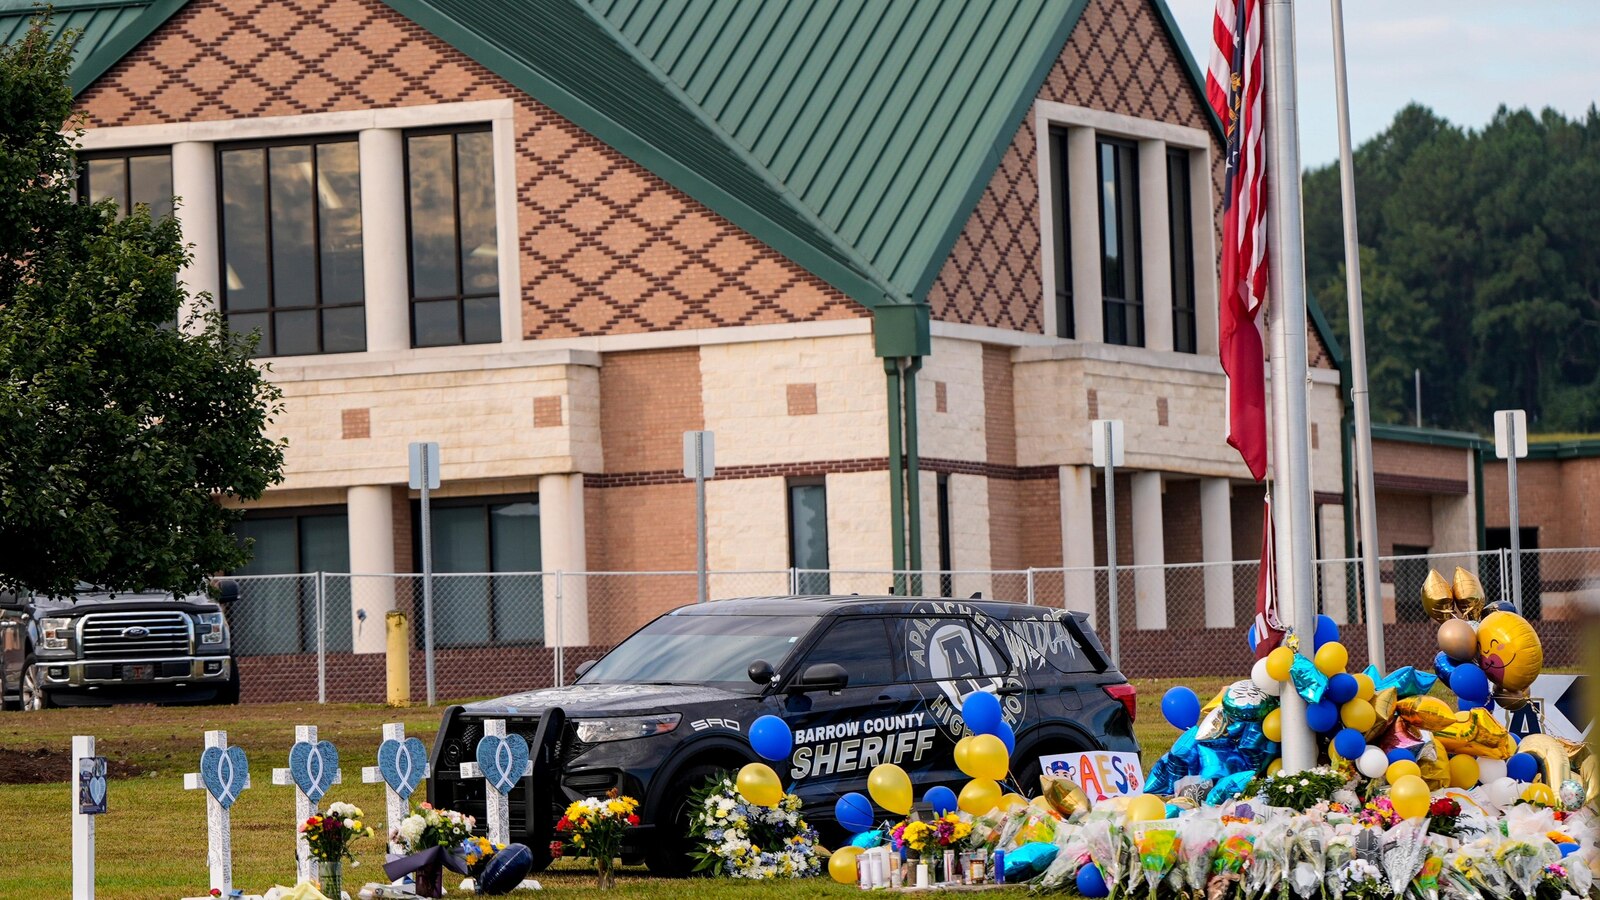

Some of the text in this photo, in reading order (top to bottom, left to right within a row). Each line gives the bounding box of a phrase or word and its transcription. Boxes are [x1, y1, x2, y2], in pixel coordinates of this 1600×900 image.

[910, 602, 1000, 667] APALACHEE
[690, 718, 740, 731] SRO
[795, 712, 925, 744] BARROW COUNTY
[790, 729, 936, 780] SHERIFF
[1080, 755, 1128, 795] AES
